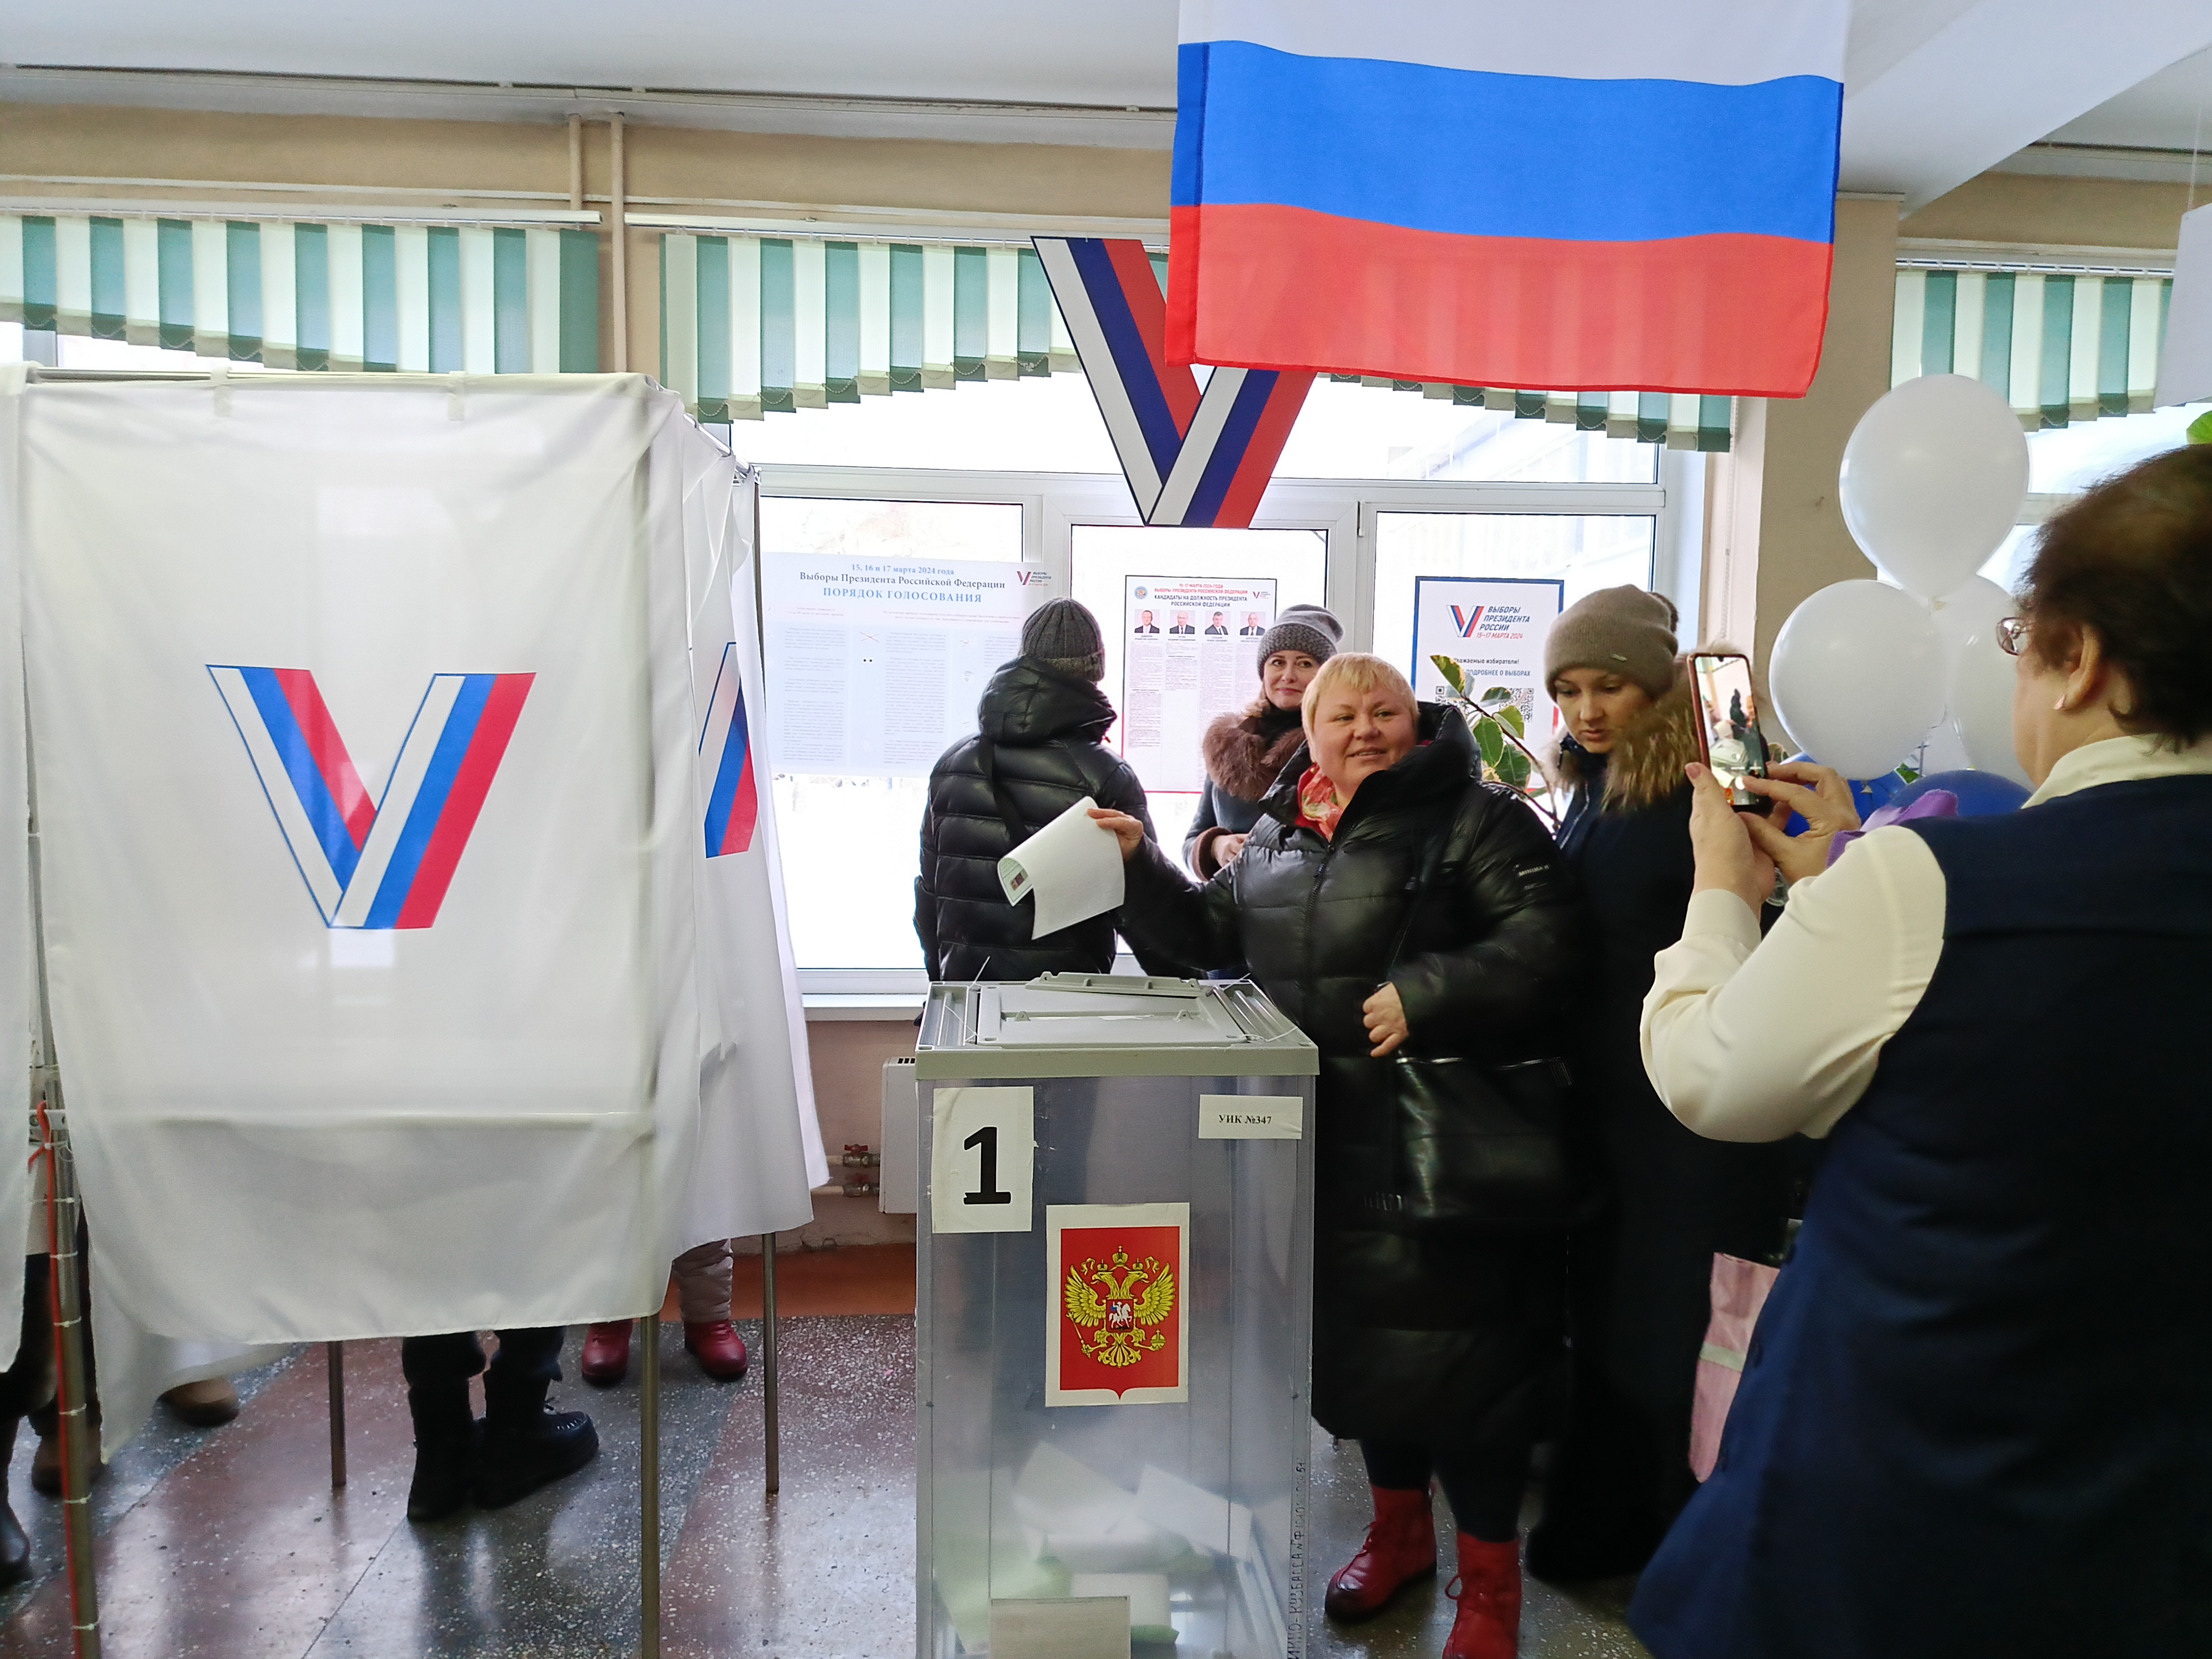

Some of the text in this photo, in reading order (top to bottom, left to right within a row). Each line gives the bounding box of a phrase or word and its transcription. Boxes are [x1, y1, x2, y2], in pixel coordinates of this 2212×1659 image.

[800, 572, 1005, 590] Выборы Президента Российской Федерации
[823, 587, 982, 603] ПОРЯДОК ГОЛОСОВАНИЯ
[1483, 615, 1531, 623] ПРЕЗИДЕНТА
[1219, 1114, 1272, 1125] УИК №347
[964, 1126, 1011, 1205] 1
